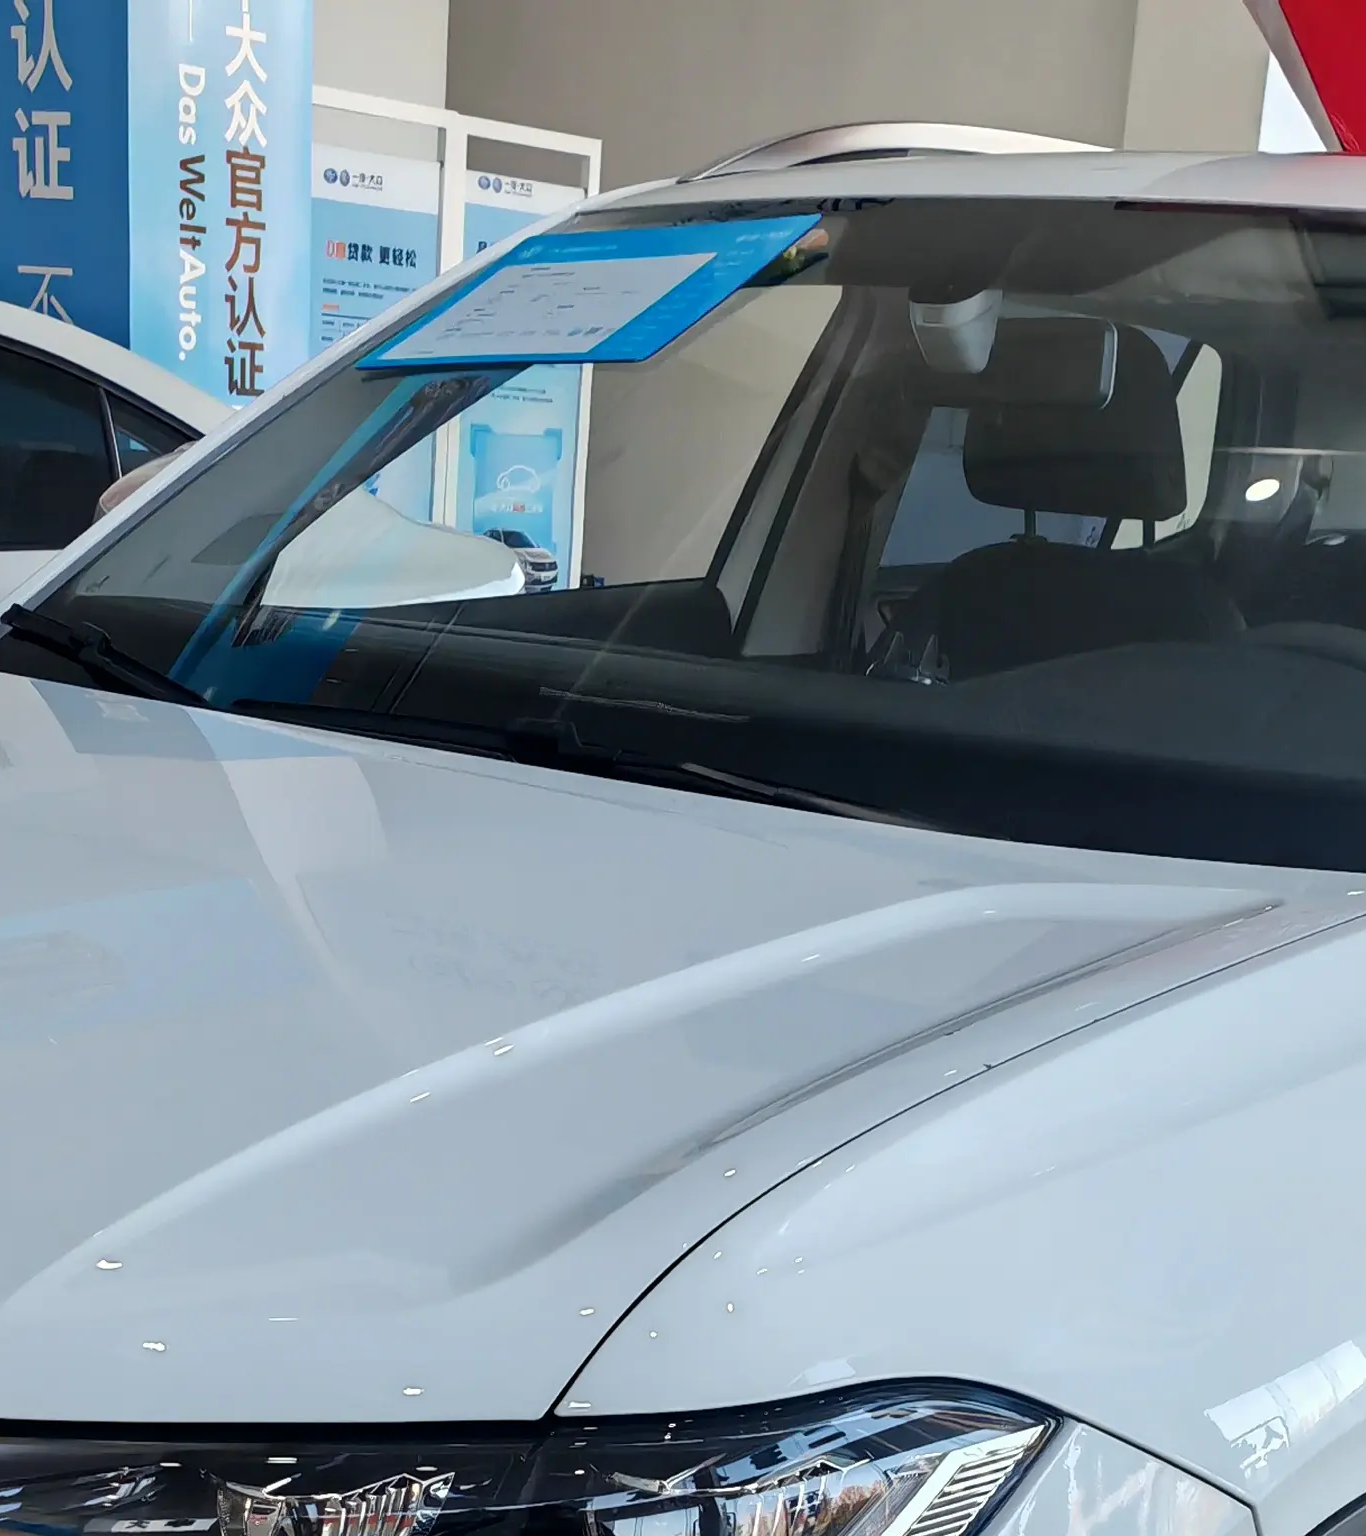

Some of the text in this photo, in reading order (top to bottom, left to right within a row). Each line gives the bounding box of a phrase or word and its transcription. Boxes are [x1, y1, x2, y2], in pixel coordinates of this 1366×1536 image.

[10, 0, 75, 326] 认证 不
[178, 63, 206, 146] Das
[223, 8, 268, 397] 大众官方认证
